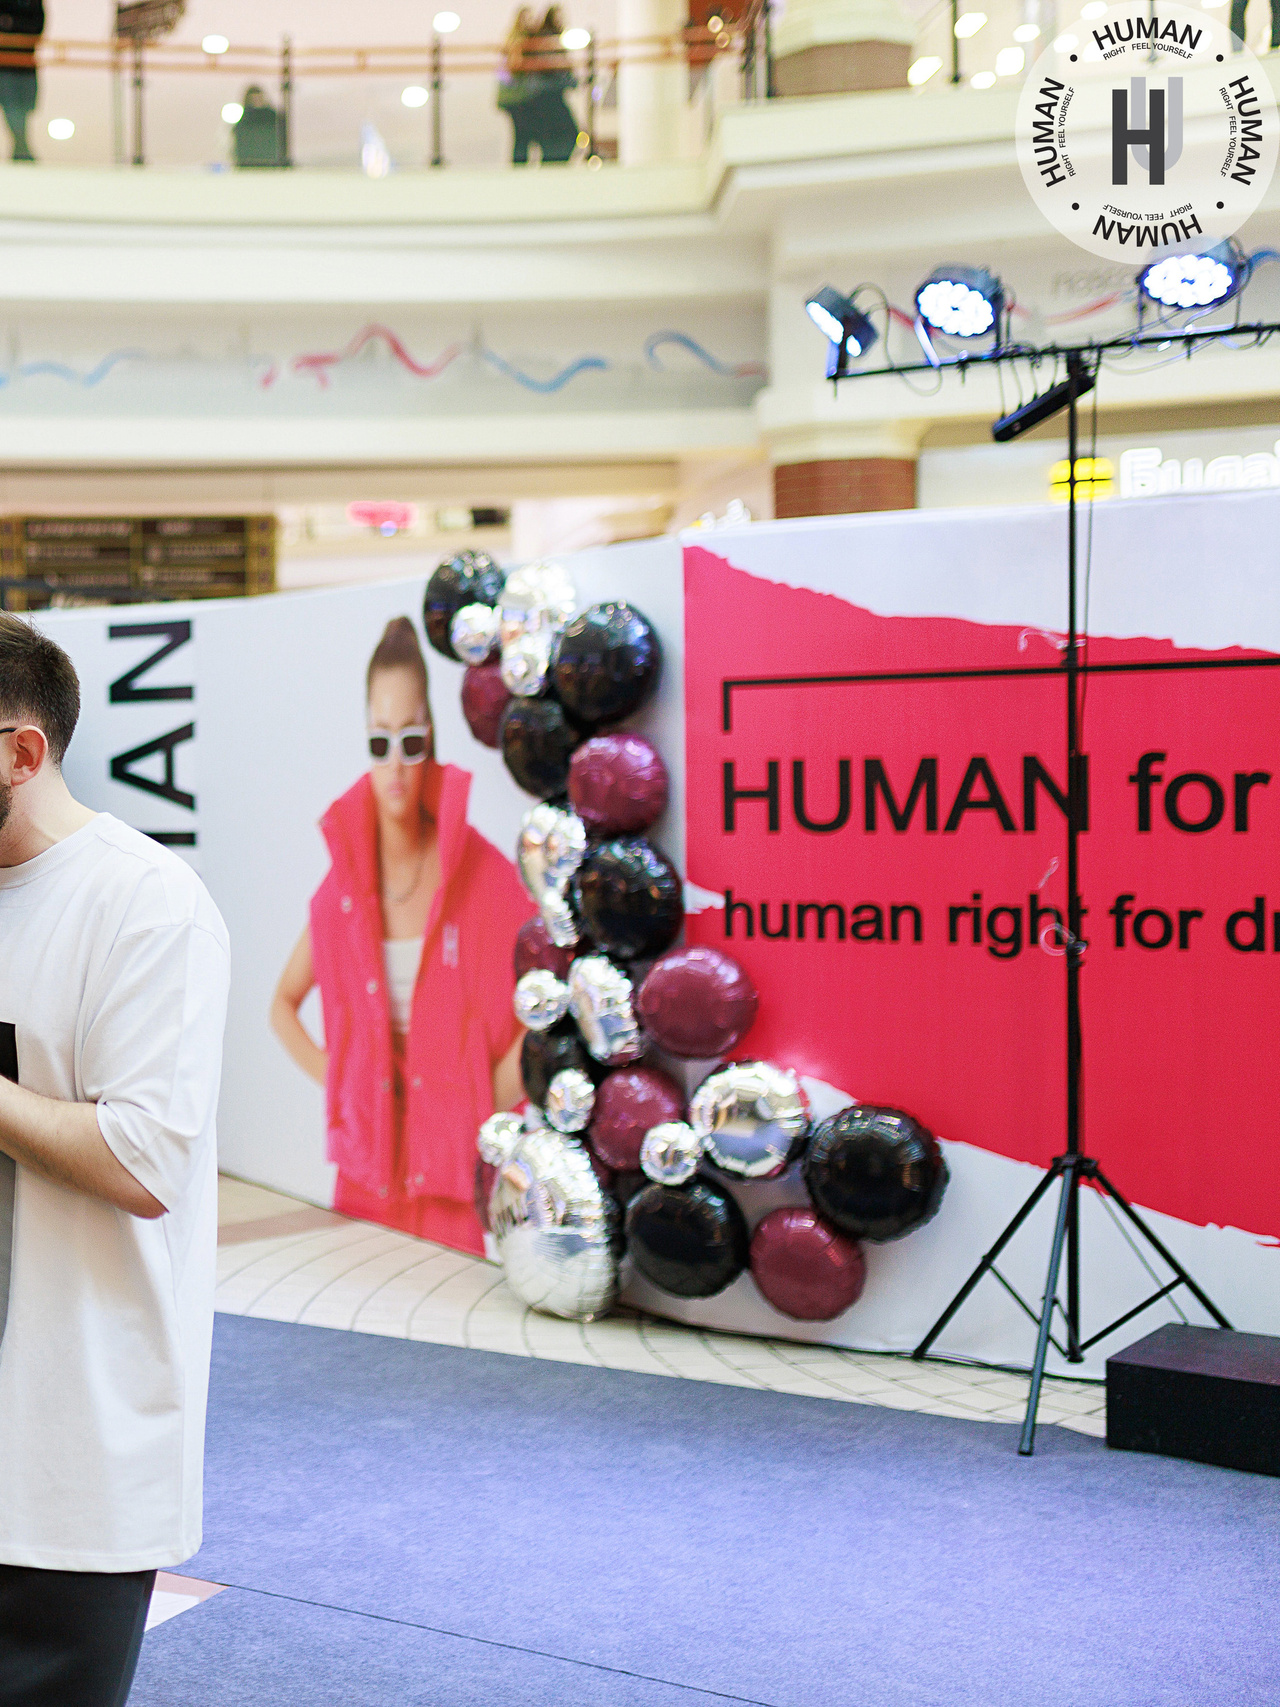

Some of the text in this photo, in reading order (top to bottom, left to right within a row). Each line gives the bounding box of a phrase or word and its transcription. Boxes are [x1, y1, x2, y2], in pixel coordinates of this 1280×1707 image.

[723, 751, 1272, 833] HUMAN for
[723, 889, 923, 941] human
[1109, 894, 1204, 950] for
[1226, 896, 1280, 952] d
